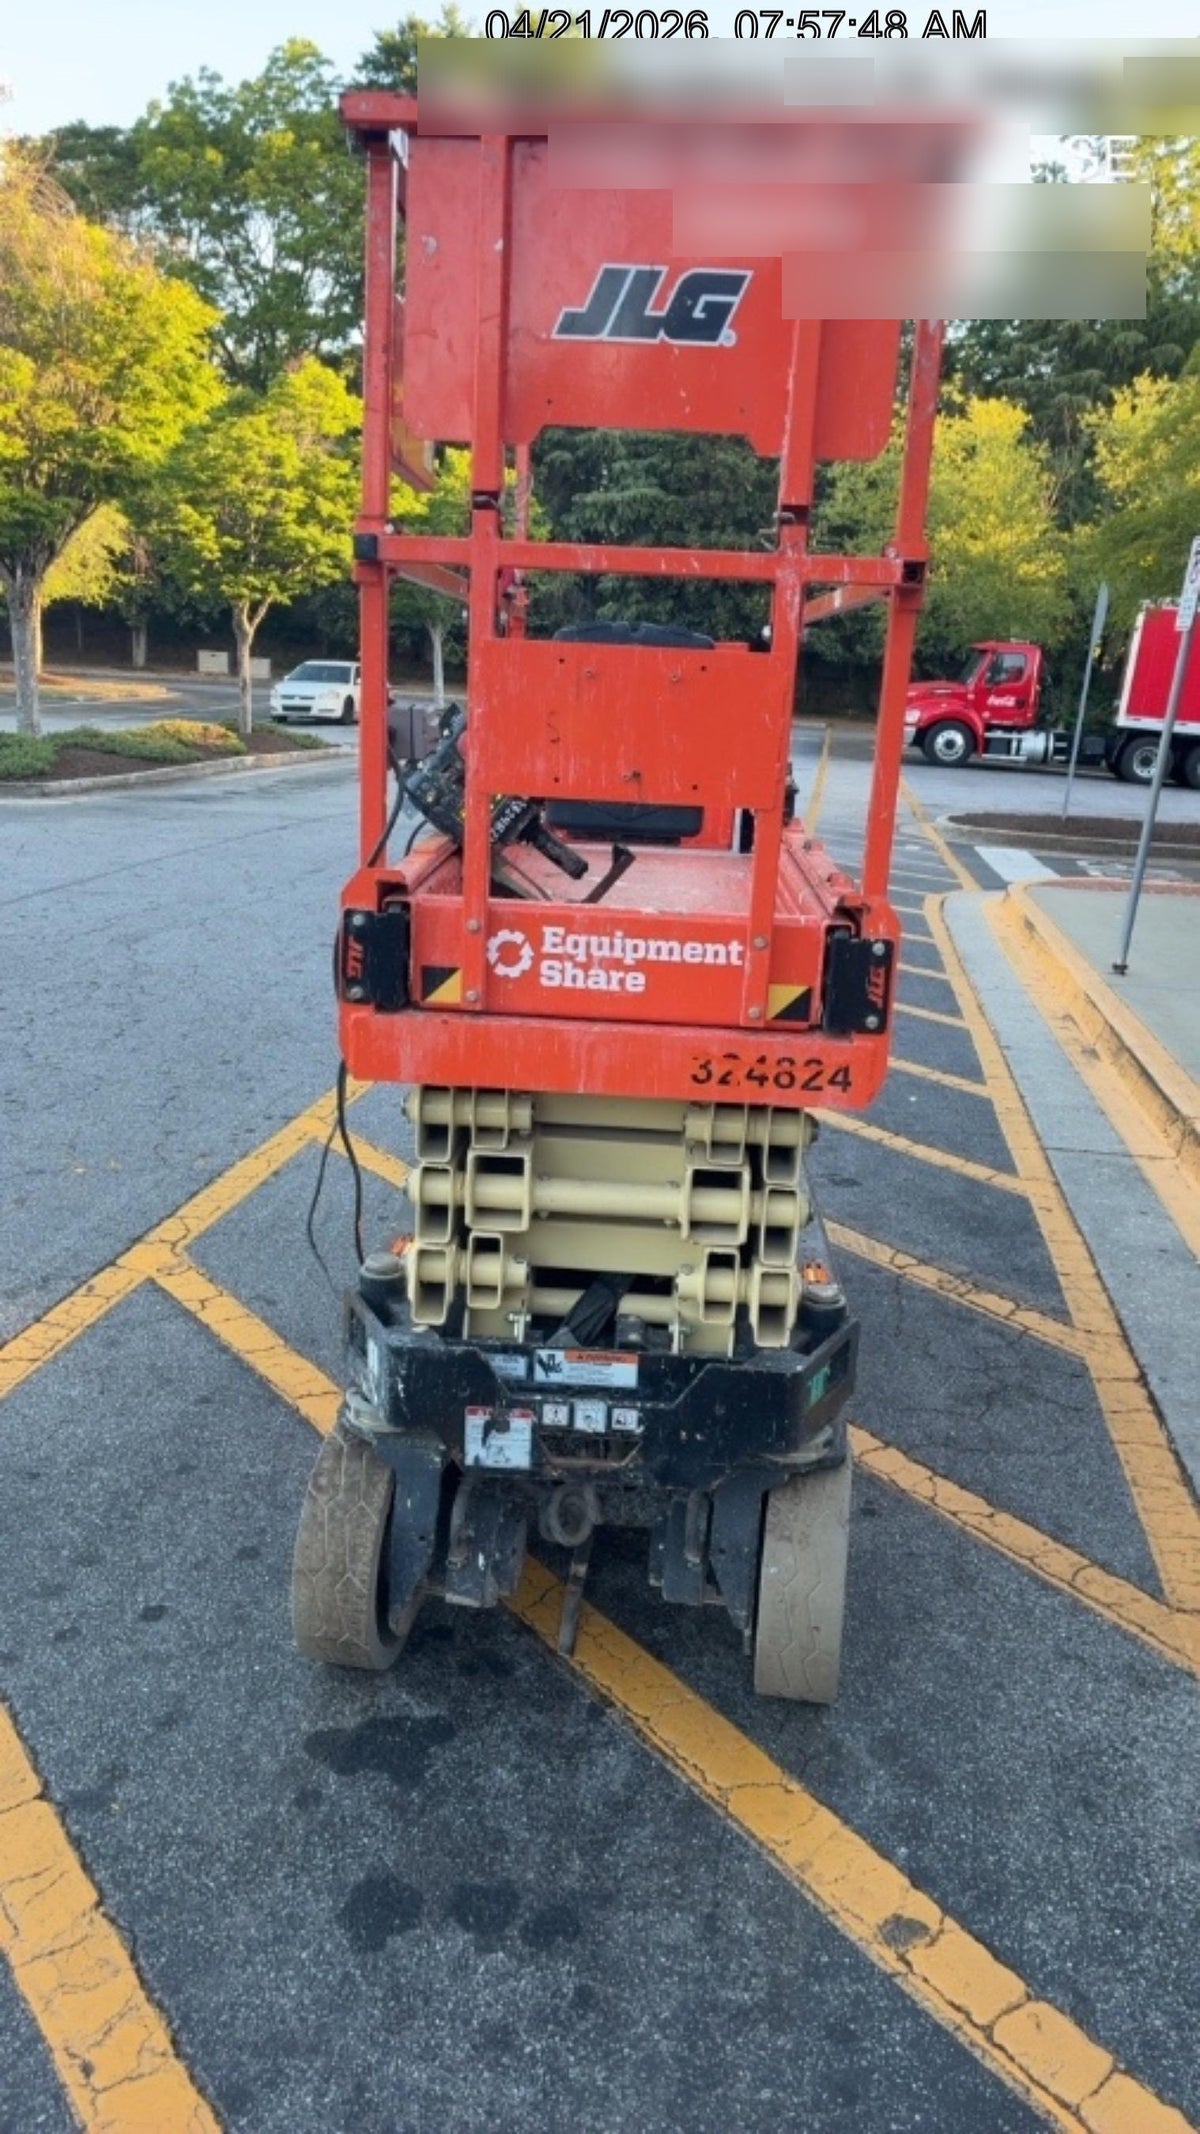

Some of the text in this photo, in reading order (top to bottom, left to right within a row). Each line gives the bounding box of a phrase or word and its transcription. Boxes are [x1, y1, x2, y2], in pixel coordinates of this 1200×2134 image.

[551, 263, 754, 347] JLG
[346, 935, 365, 979] JLG
[541, 926, 744, 965] Equipment
[539, 959, 646, 992] Share
[867, 966, 886, 1009] JLG
[690, 1052, 853, 1093] 324824
